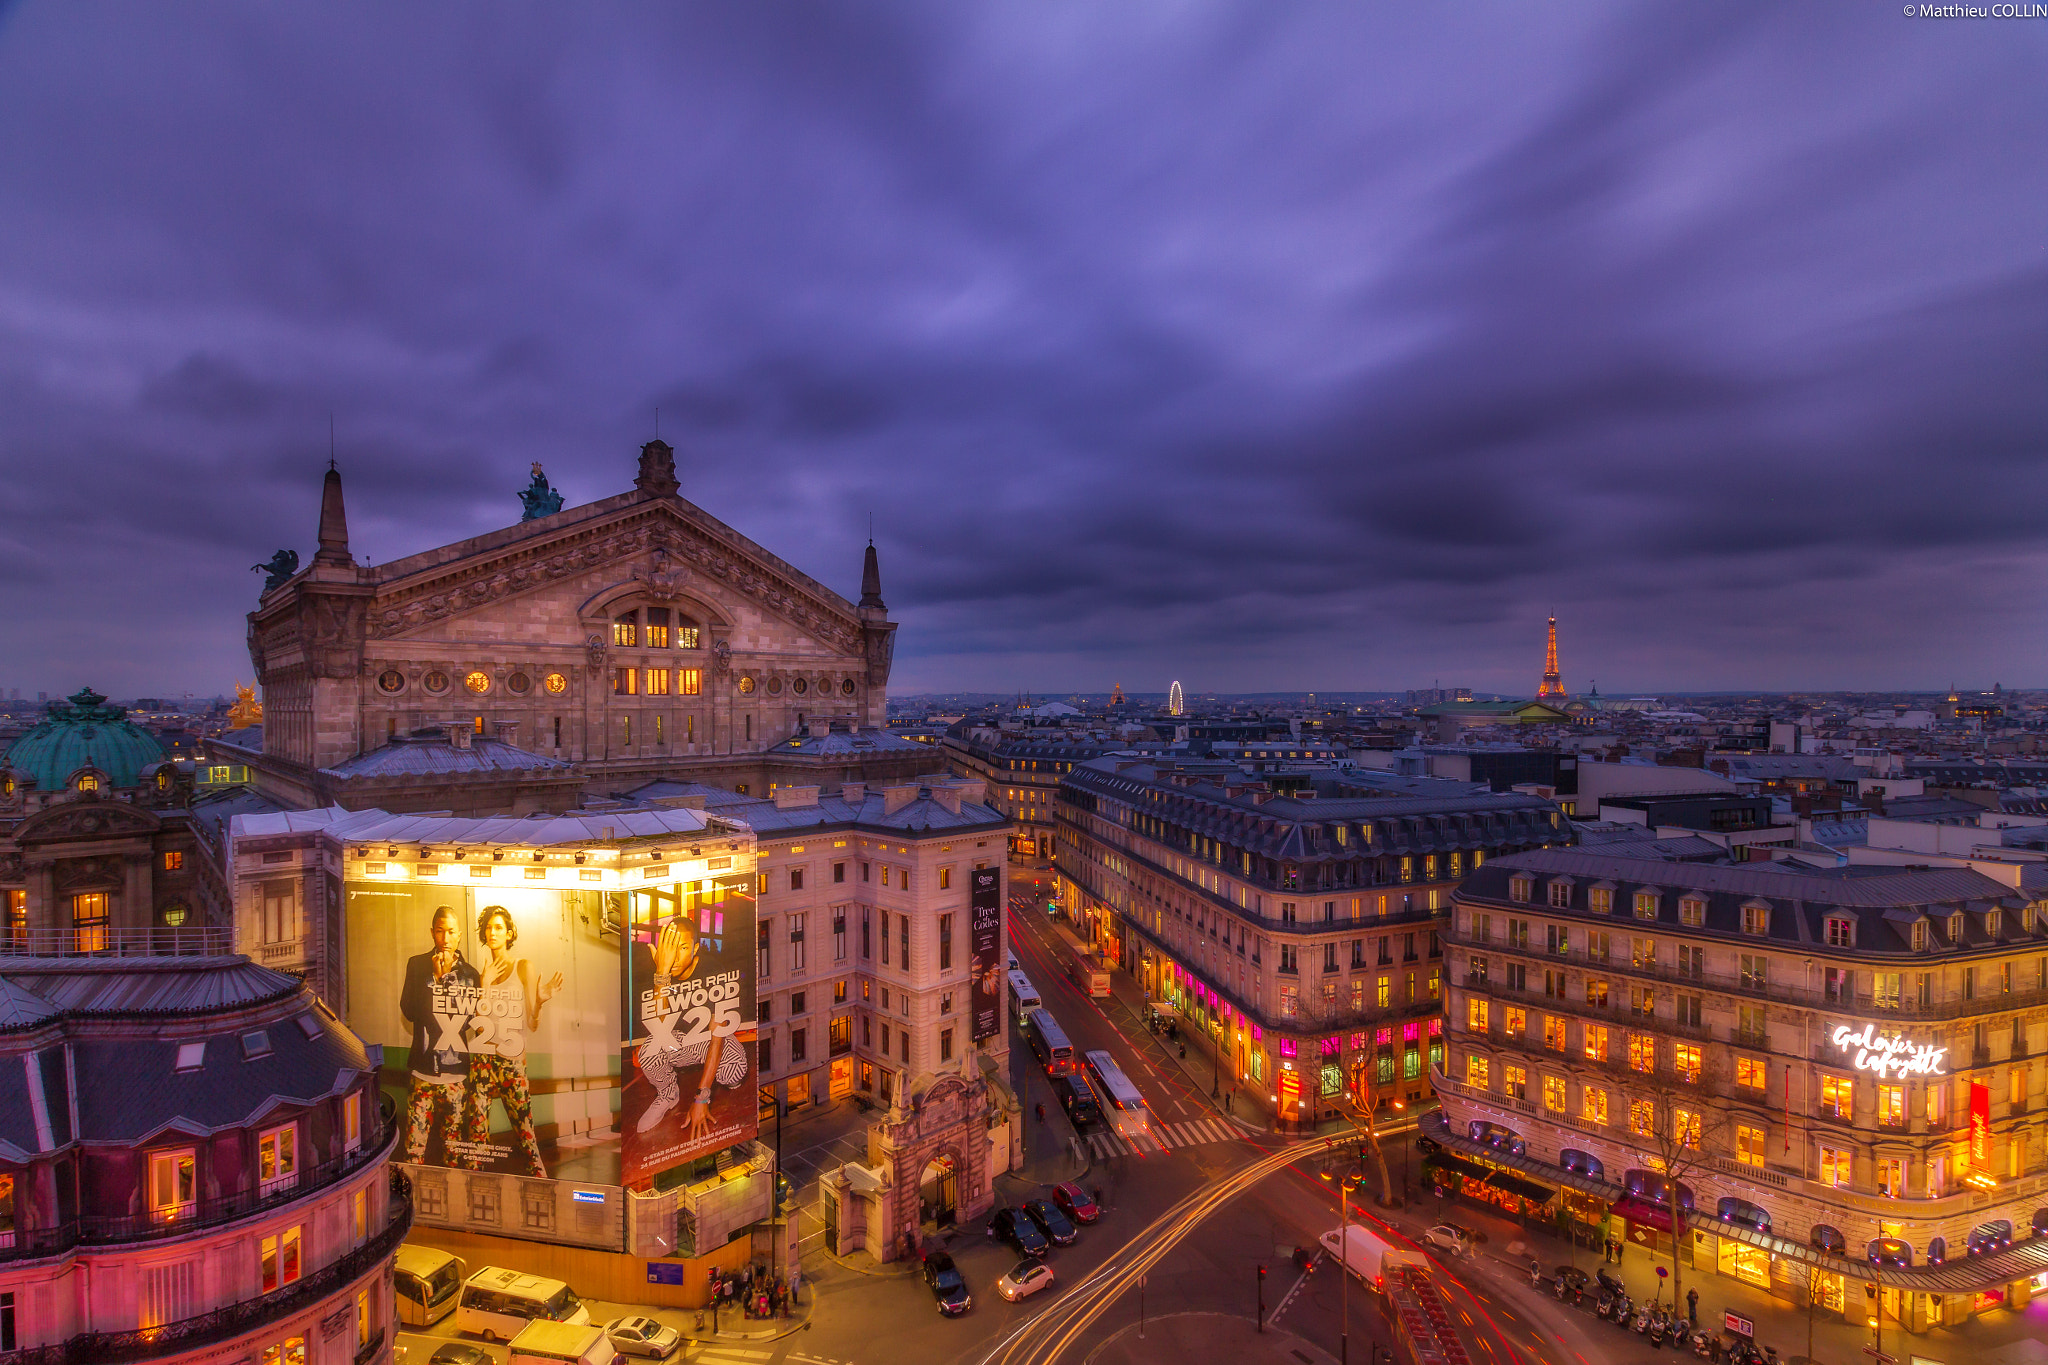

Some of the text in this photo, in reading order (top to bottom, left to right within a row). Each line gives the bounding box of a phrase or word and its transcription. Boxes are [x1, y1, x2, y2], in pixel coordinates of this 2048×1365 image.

[736, 882, 749, 892] 12
[973, 917, 999, 931] Codes
[978, 906, 996, 918] Tree
[432, 984, 524, 1001] G-STAR RAW
[641, 969, 740, 1002] G-STAR RAW
[432, 995, 524, 1019] ELWOOD
[641, 981, 740, 1021] ELWOOD
[432, 1012, 525, 1058] X25
[641, 996, 742, 1059] X25
[1832, 1023, 1917, 1055] Galeries
[1854, 1044, 1949, 1080] Lafayette
[715, 1123, 740, 1137] BASTILLE
